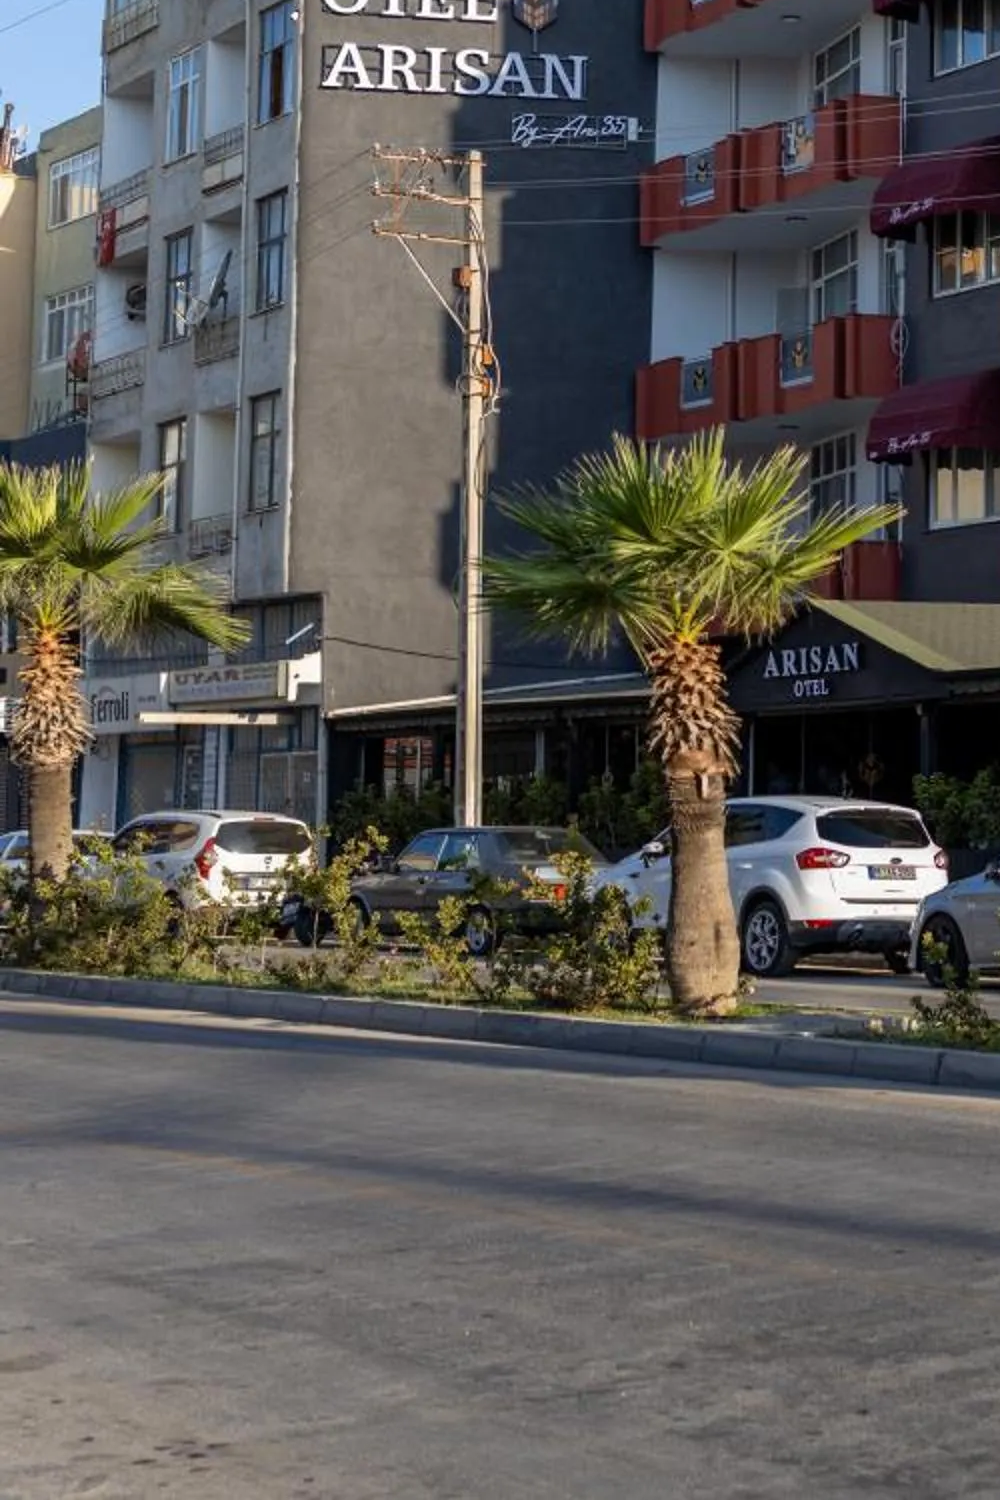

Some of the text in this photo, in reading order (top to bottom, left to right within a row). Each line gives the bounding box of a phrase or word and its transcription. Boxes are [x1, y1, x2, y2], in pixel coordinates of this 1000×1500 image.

[321, 41, 589, 100] ARISAN
[763, 642, 859, 678] ARISAN
[794, 679, 829, 697] OTEL
